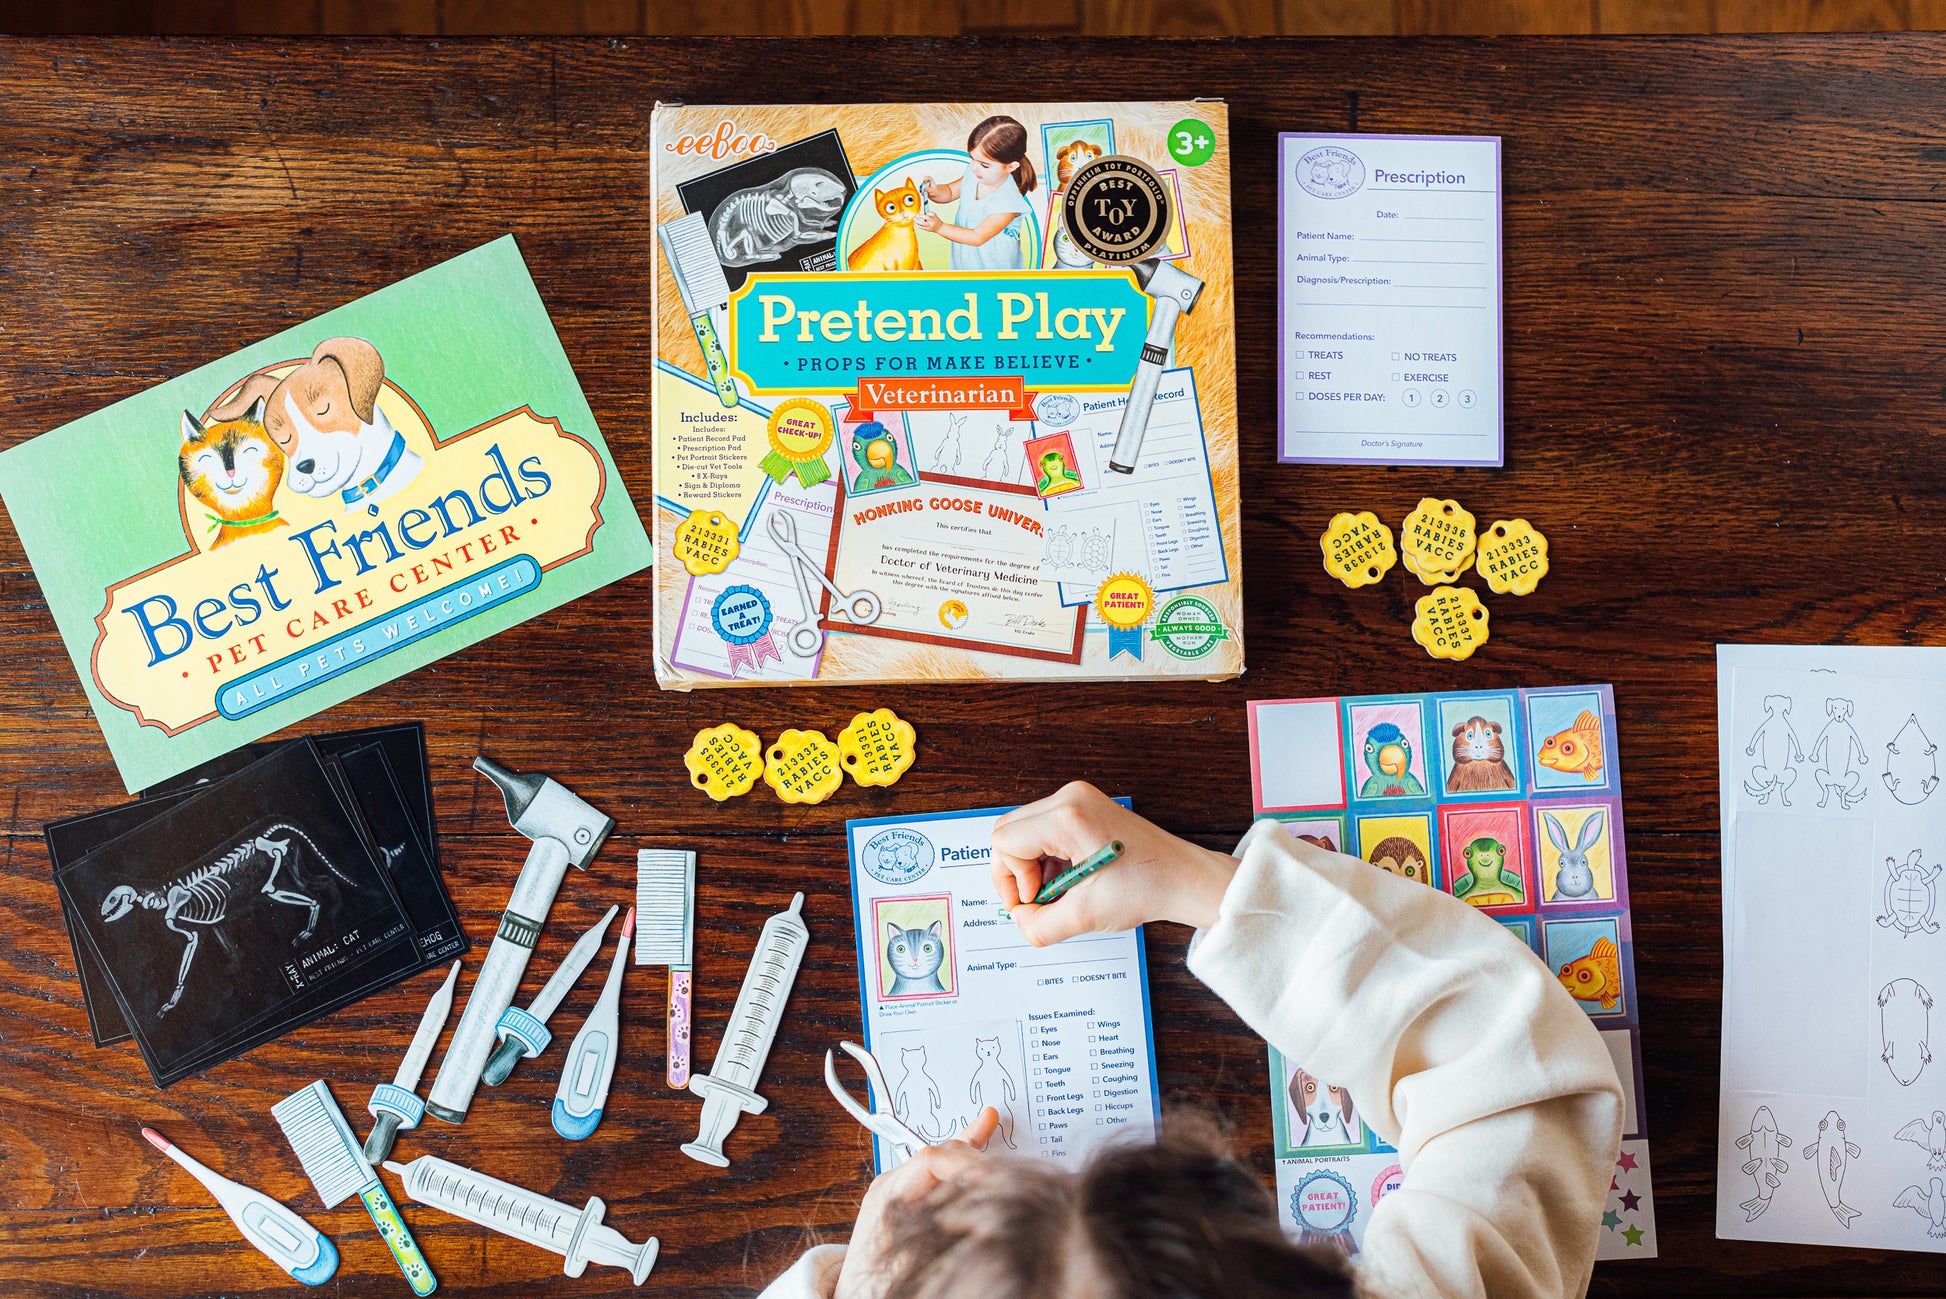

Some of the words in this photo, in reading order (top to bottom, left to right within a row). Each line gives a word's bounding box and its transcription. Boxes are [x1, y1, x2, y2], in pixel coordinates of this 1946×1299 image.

[1175, 131, 1209, 155] 3+
[1303, 151, 1324, 165] Best
[1325, 149, 1357, 166] Friends
[1067, 165, 1102, 207] OPPENHEIM
[1104, 162, 1122, 171] TOY
[1374, 169, 1466, 187] Prescription
[1099, 180, 1134, 192] BEST
[1094, 198, 1138, 226] TOY
[1376, 210, 1399, 219] Date:
[1091, 226, 1141, 243] AWARD
[1296, 232, 1325, 240] Patient
[1327, 232, 1355, 241] Name:
[1083, 242, 1151, 260] PLATINUM
[1296, 254, 1326, 262] Animal
[1327, 254, 1350, 264] Type:
[1296, 275, 1392, 287] Diagnosis/Prescription:
[758, 292, 983, 343] Pretend
[997, 292, 1126, 352] Play
[1295, 331, 1375, 341] Recommendations:
[1308, 351, 1344, 360] TREATS
[1404, 352, 1421, 361] NO
[1422, 353, 1457, 362] TREATS
[797, 356, 867, 372] PROPS
[875, 356, 918, 371] FOR
[926, 355, 986, 371] MAKE
[994, 354, 1081, 370] BELIEVE
[1308, 372, 1332, 380] REST
[1404, 373, 1449, 382] EXERCISE
[866, 383, 1017, 406] Veterinarian
[1308, 393, 1342, 401] DOSES
[1343, 393, 1362, 401] PER
[1363, 393, 1386, 402] DAY:
[1437, 394, 1443, 403] 2
[1464, 395, 1471, 403] 3
[1083, 399, 1116, 412] Patient
[680, 412, 738, 423] Includes:
[786, 418, 816, 429] GREAT
[777, 426, 822, 440] CHECK-UP!
[682, 444, 727, 452] Prescription
[1361, 439, 1390, 448] Doctor's
[1390, 440, 1424, 449] Signature
[677, 453, 689, 461] Pet
[690, 453, 718, 461] Portrait
[718, 453, 748, 461] Stickers
[702, 473, 728, 481] X-Rays
[684, 482, 701, 490] Sign
[709, 482, 741, 490] Diploma
[774, 491, 834, 513] Prescription
[853, 498, 924, 526] HONKING
[929, 497, 982, 514] GOOSE
[936, 522, 949, 530] This
[950, 524, 977, 533] certifies
[978, 528, 993, 536] that
[1421, 514, 1466, 538] 213336
[690, 524, 730, 545] 213331
[1332, 522, 1369, 549] VACC
[1413, 524, 1464, 551] RABIES
[683, 534, 729, 557] RABIES
[1335, 529, 1381, 563] RABIES
[1415, 539, 1454, 561] VACC
[1486, 535, 1531, 561] 213333
[121, 561, 293, 669] Best
[289, 443, 552, 595] Friends
[685, 546, 719, 565] VACC
[882, 543, 893, 551] has
[929, 549, 940, 557] the
[996, 559, 1008, 567] the
[1009, 561, 1031, 572] degree
[1344, 542, 1386, 572] 213338
[1488, 546, 1539, 574] RABIES
[880, 555, 917, 569] Doctor
[919, 561, 933, 571] of
[935, 562, 991, 581] Veterinary
[993, 570, 1039, 586] Medicine
[1499, 560, 1539, 582] VACC
[205, 633, 268, 675] PET
[286, 588, 375, 640] CARE
[389, 527, 522, 594] CENTER
[1109, 592, 1139, 600] GREAT
[721, 599, 758, 617] EARNED
[1104, 601, 1145, 609] PATIENT!
[738, 612, 746, 620] A
[1450, 596, 1473, 642] 213337
[728, 616, 761, 632] TREAT!
[1162, 625, 1193, 633] ALWAYS
[1194, 624, 1217, 632] GOOD
[1426, 606, 1447, 647] VACC
[1436, 597, 1461, 649] RABIES
[235, 676, 284, 706] ALL
[299, 639, 367, 678] PETS
[381, 569, 524, 641] WELCOME!
[867, 720, 892, 772] RABIES
[881, 722, 902, 763] VACC
[723, 734, 752, 770] VACC
[856, 728, 879, 774] 213331
[709, 737, 747, 783] RABIES
[777, 742, 818, 776] 213332
[700, 747, 735, 788] 213335
[782, 751, 828, 789] RABIES
[795, 765, 831, 795] VACC
[869, 835, 890, 850] Best
[891, 831, 925, 847] Friends
[873, 871, 886, 880] PET
[903, 867, 926, 881] CENTER
[961, 899, 988, 908] Name:
[963, 919, 998, 928] Address:
[301, 943, 339, 969] ANIMAL:
[342, 929, 361, 945] CAT
[966, 962, 995, 972] Animal
[996, 960, 1018, 971] Type:
[285, 964, 305, 990] X-RAY
[1044, 977, 1064, 986] BITES
[1079, 973, 1111, 983] DOESN'T
[1112, 972, 1127, 980] BITE
[1028, 1013, 1053, 1021] Issues
[1053, 1008, 1096, 1019] Examined:
[1040, 1026, 1058, 1035] Eyes
[1097, 1020, 1121, 1029] Wings
[1041, 1039, 1061, 1047] Nose
[1098, 1034, 1119, 1042] Heart
[1042, 1053, 1059, 1061] Ears
[1100, 1047, 1135, 1056] Breathing
[1044, 1066, 1072, 1076] Tongue
[1101, 1060, 1135, 1069] Sneezing
[1045, 1080, 1066, 1088] Teeth
[1102, 1074, 1138, 1083] Coughing
[1046, 1094, 1066, 1102] Front
[1067, 1093, 1084, 1101] Legs
[1103, 1088, 1139, 1097] Digestion
[1048, 1107, 1066, 1116] Back
[1067, 1106, 1084, 1115] Legs
[1105, 1102, 1134, 1111] Hiccups
[1049, 1122, 1068, 1130] Paws
[1106, 1116, 1128, 1125] Other
[1050, 1135, 1063, 1143] Tail
[1051, 1149, 1067, 1157] Fins
[1287, 1157, 1314, 1165] ANIMAL
[1315, 1155, 1351, 1164] PORTRAITS
[1307, 1192, 1339, 1201] GREAT
[1302, 1202, 1346, 1212] PATIENT!
